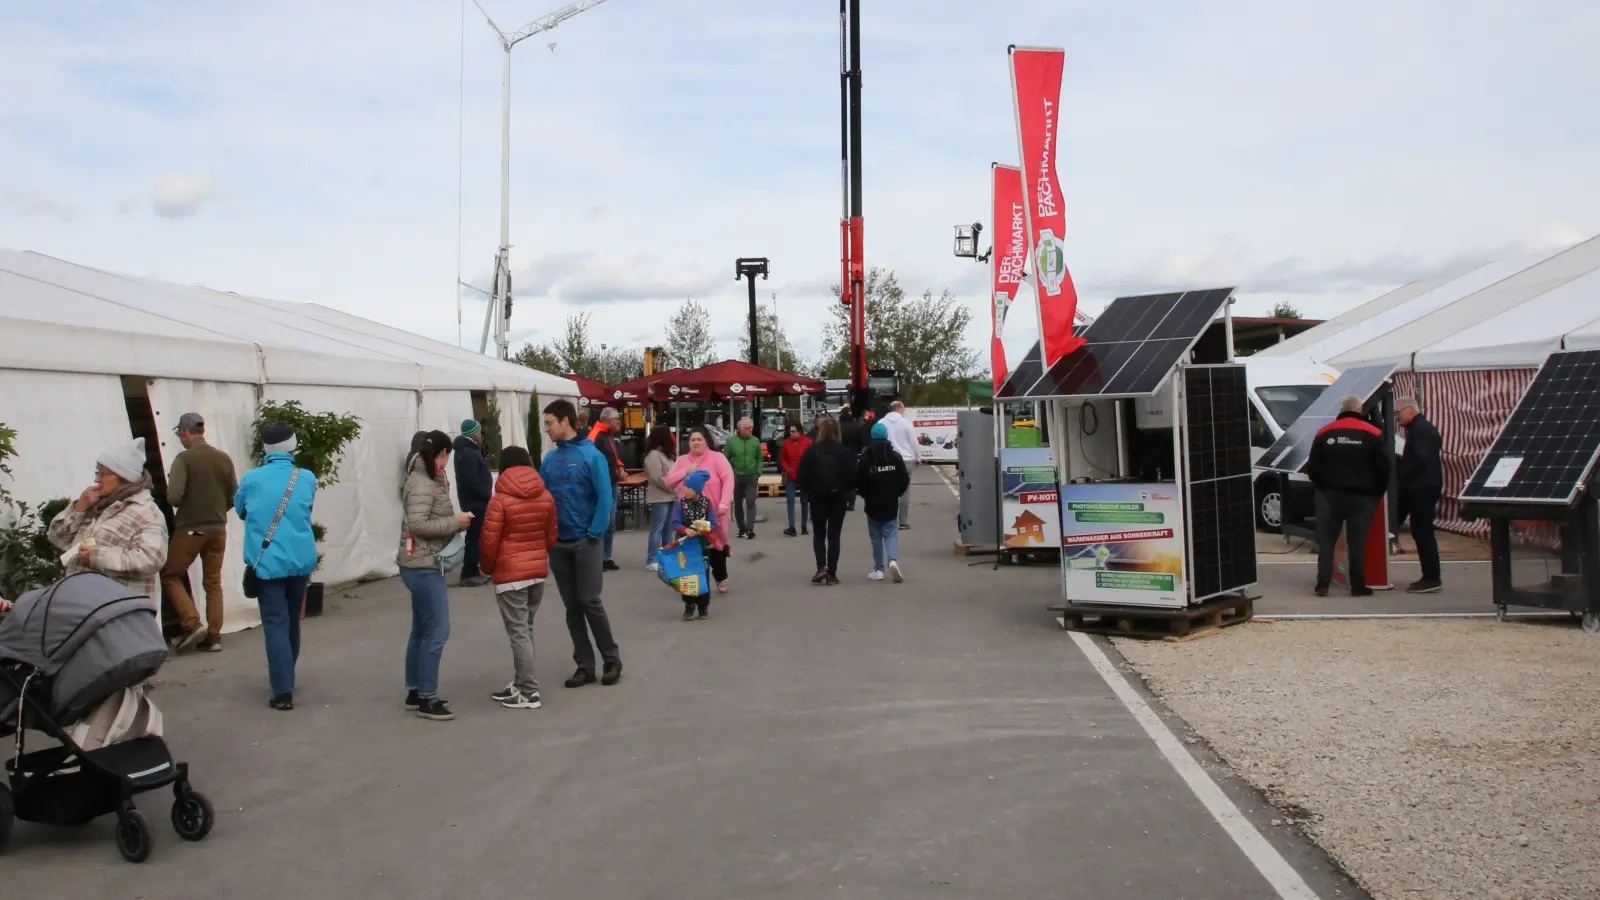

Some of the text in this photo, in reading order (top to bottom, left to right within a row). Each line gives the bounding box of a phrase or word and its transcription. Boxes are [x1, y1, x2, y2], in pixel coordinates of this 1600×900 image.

[1010, 202, 1024, 284] FACHMARKT
[998, 256, 1012, 284] DER
[1066, 534, 1109, 543] WARMWASSER
[1123, 530, 1169, 539] SONNENKRAFT
